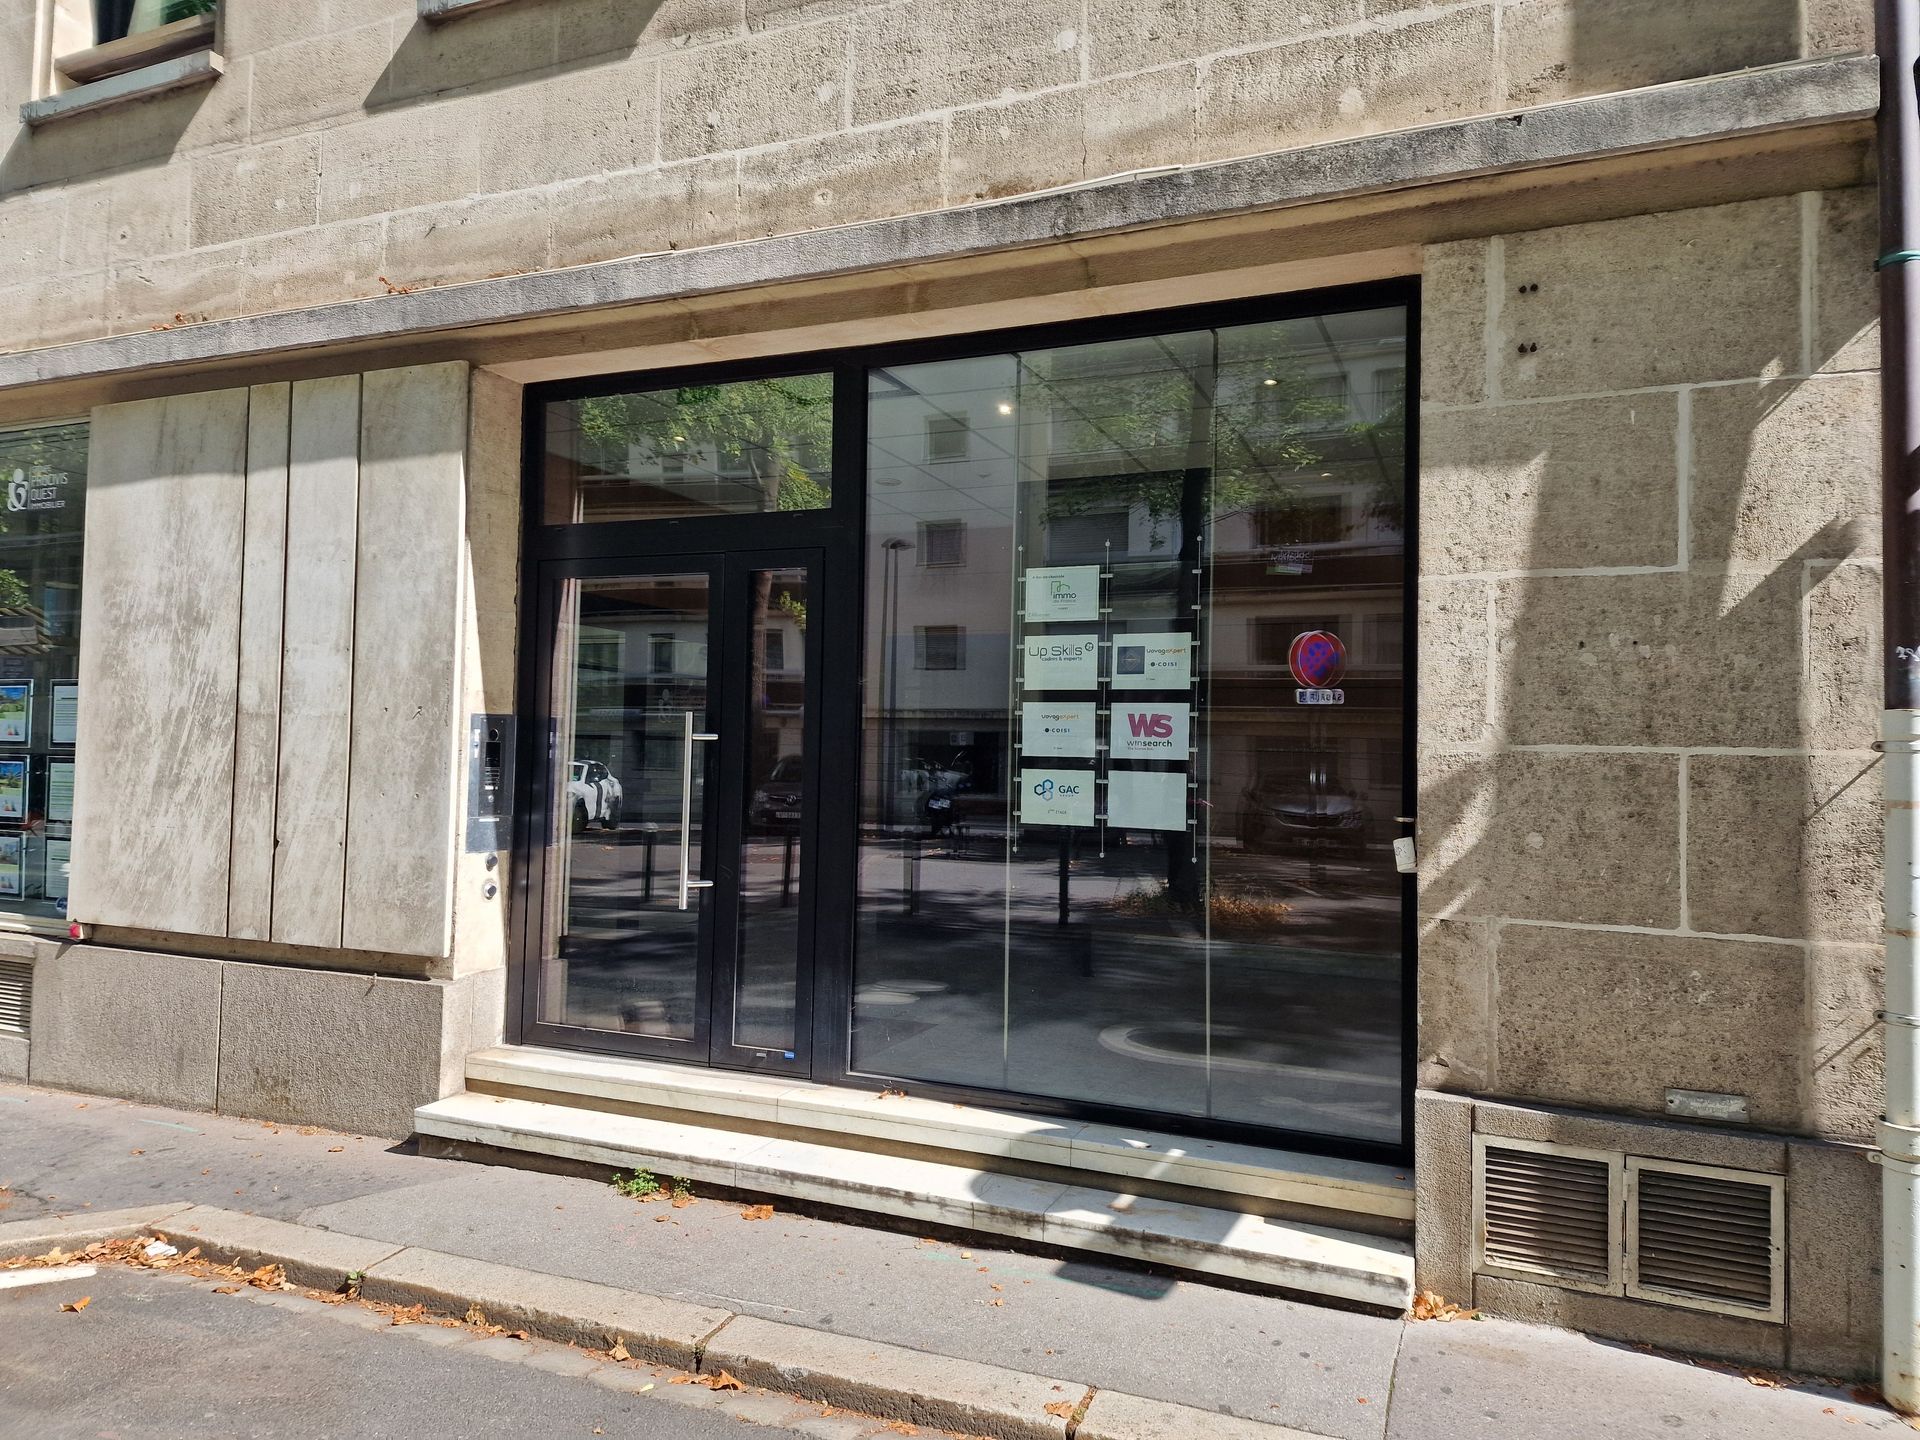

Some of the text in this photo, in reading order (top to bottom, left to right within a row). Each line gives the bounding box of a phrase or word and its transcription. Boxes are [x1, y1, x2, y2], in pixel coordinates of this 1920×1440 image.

[1029, 644, 1083, 659] Up Skills
[1127, 713, 1173, 738] WS
[1126, 739, 1173, 748] winsearch
[1058, 785, 1080, 794] GAC
